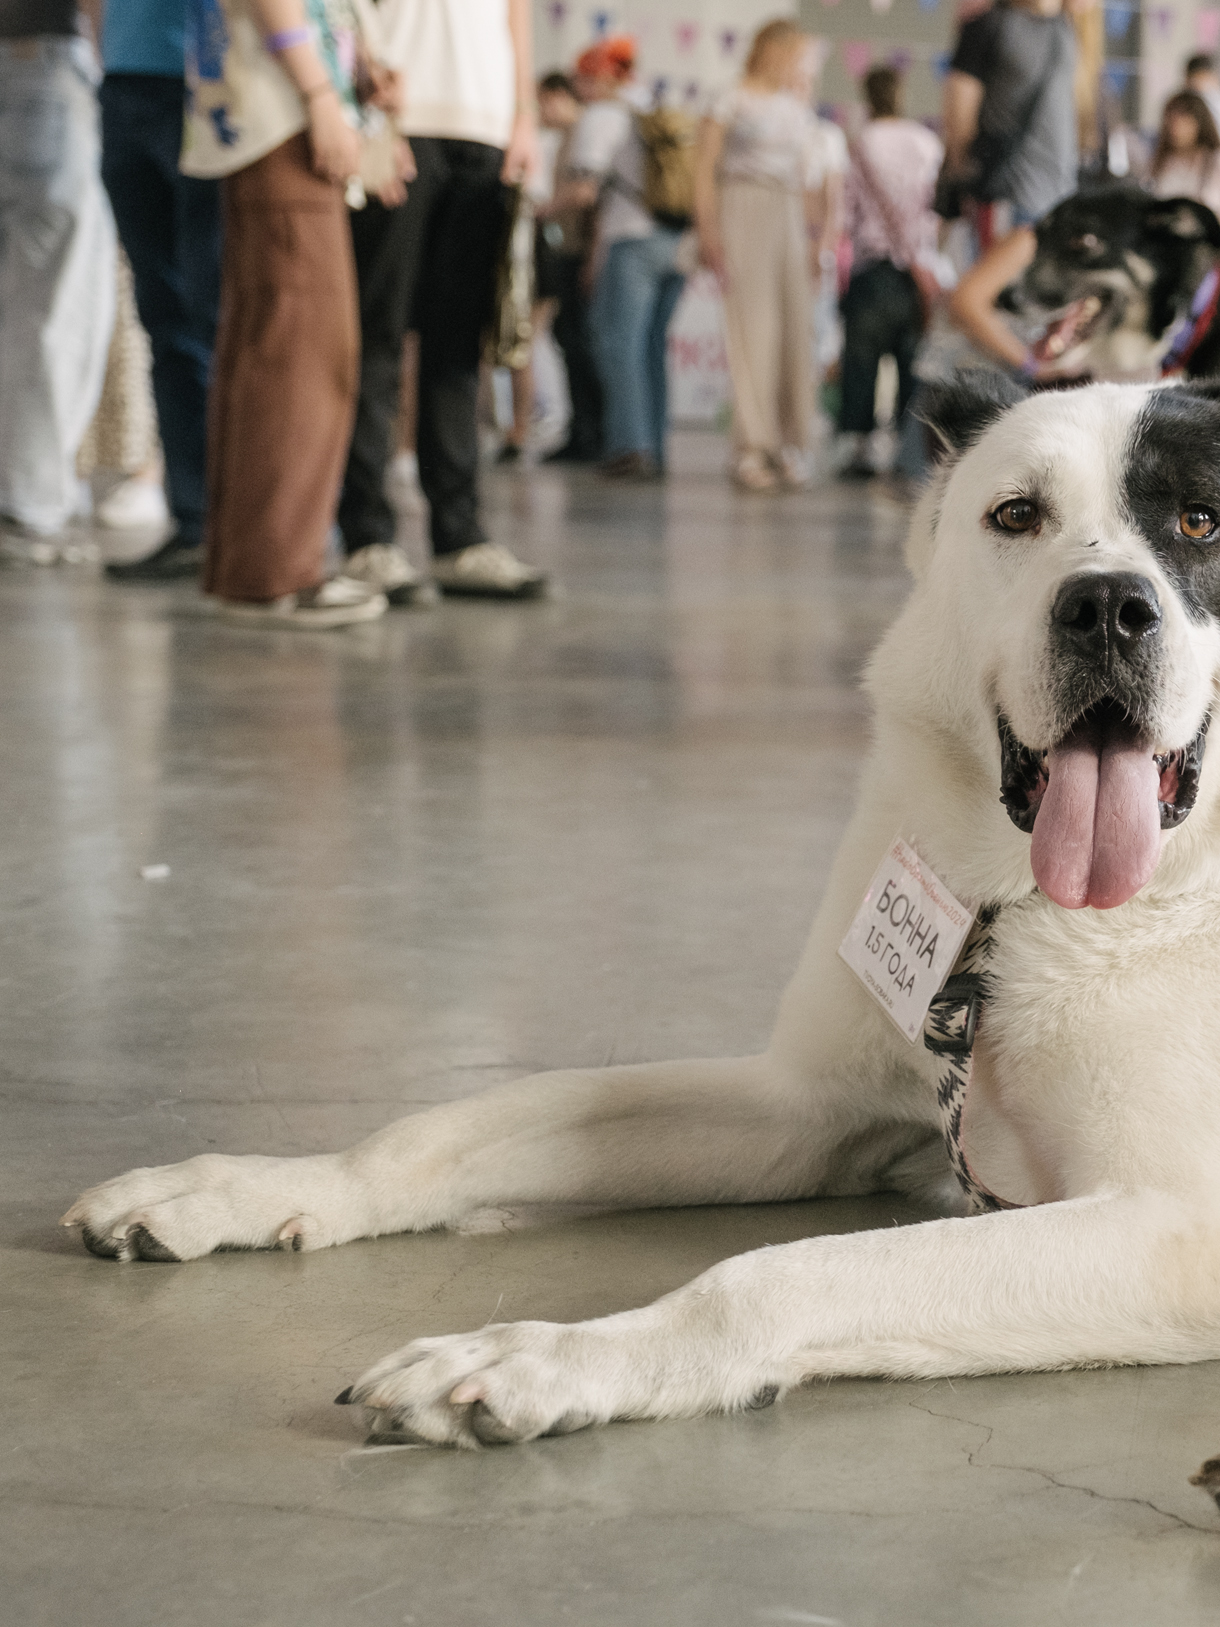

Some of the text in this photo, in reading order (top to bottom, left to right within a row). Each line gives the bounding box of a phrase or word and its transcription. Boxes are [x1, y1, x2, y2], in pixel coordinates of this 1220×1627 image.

[865, 925, 916, 997] 1.5 ГОДА
[876, 879, 939, 969] БОННА
